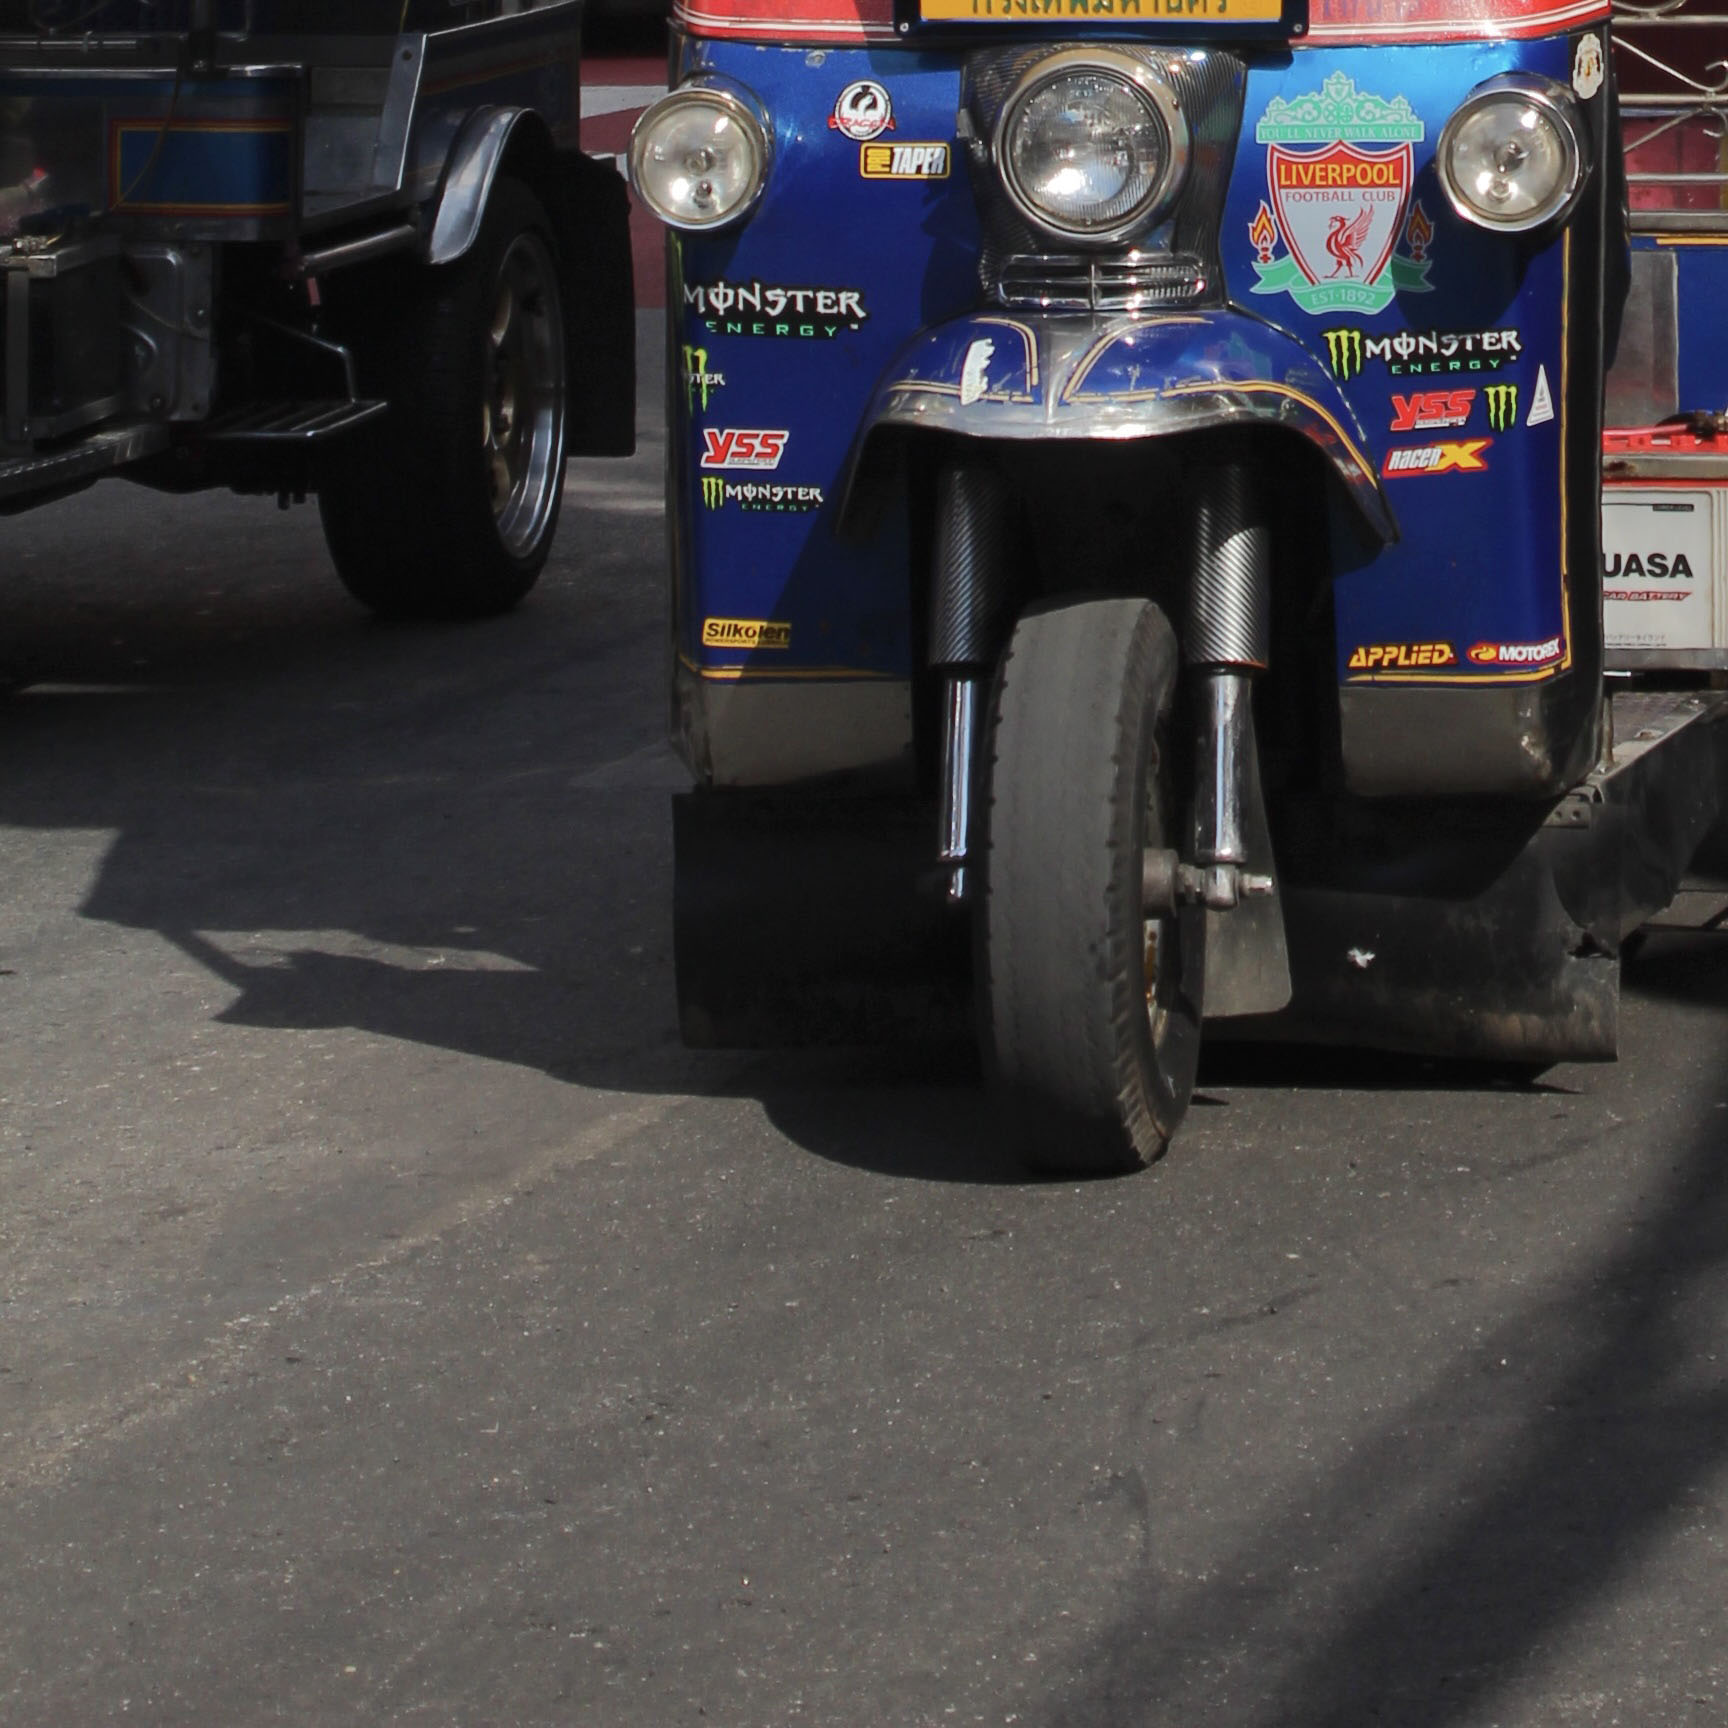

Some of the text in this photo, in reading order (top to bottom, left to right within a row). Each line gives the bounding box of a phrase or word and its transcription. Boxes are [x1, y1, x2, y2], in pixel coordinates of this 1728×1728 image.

[1304, 126, 1341, 140] NEVER
[1342, 126, 1378, 140] WALK
[1379, 125, 1419, 139] ALONE
[890, 146, 946, 175] TAPER
[1279, 163, 1400, 186] LIVERPOOL
[1284, 190, 1396, 203] FOOTBALL CLUB
[683, 281, 867, 319] MONSTER
[705, 320, 838, 337] ENERGY
[1365, 330, 1522, 362] MONSTER
[1391, 358, 1501, 375] ENERGY
[1391, 389, 1476, 431] YSS
[704, 430, 786, 465] YSS
[725, 482, 824, 503] MONSTER
[740, 502, 809, 512] ENERGY
[1602, 553, 1694, 579] UASA
[705, 620, 791, 641] Silkolen
[1498, 638, 1560, 662] MOTOREX
